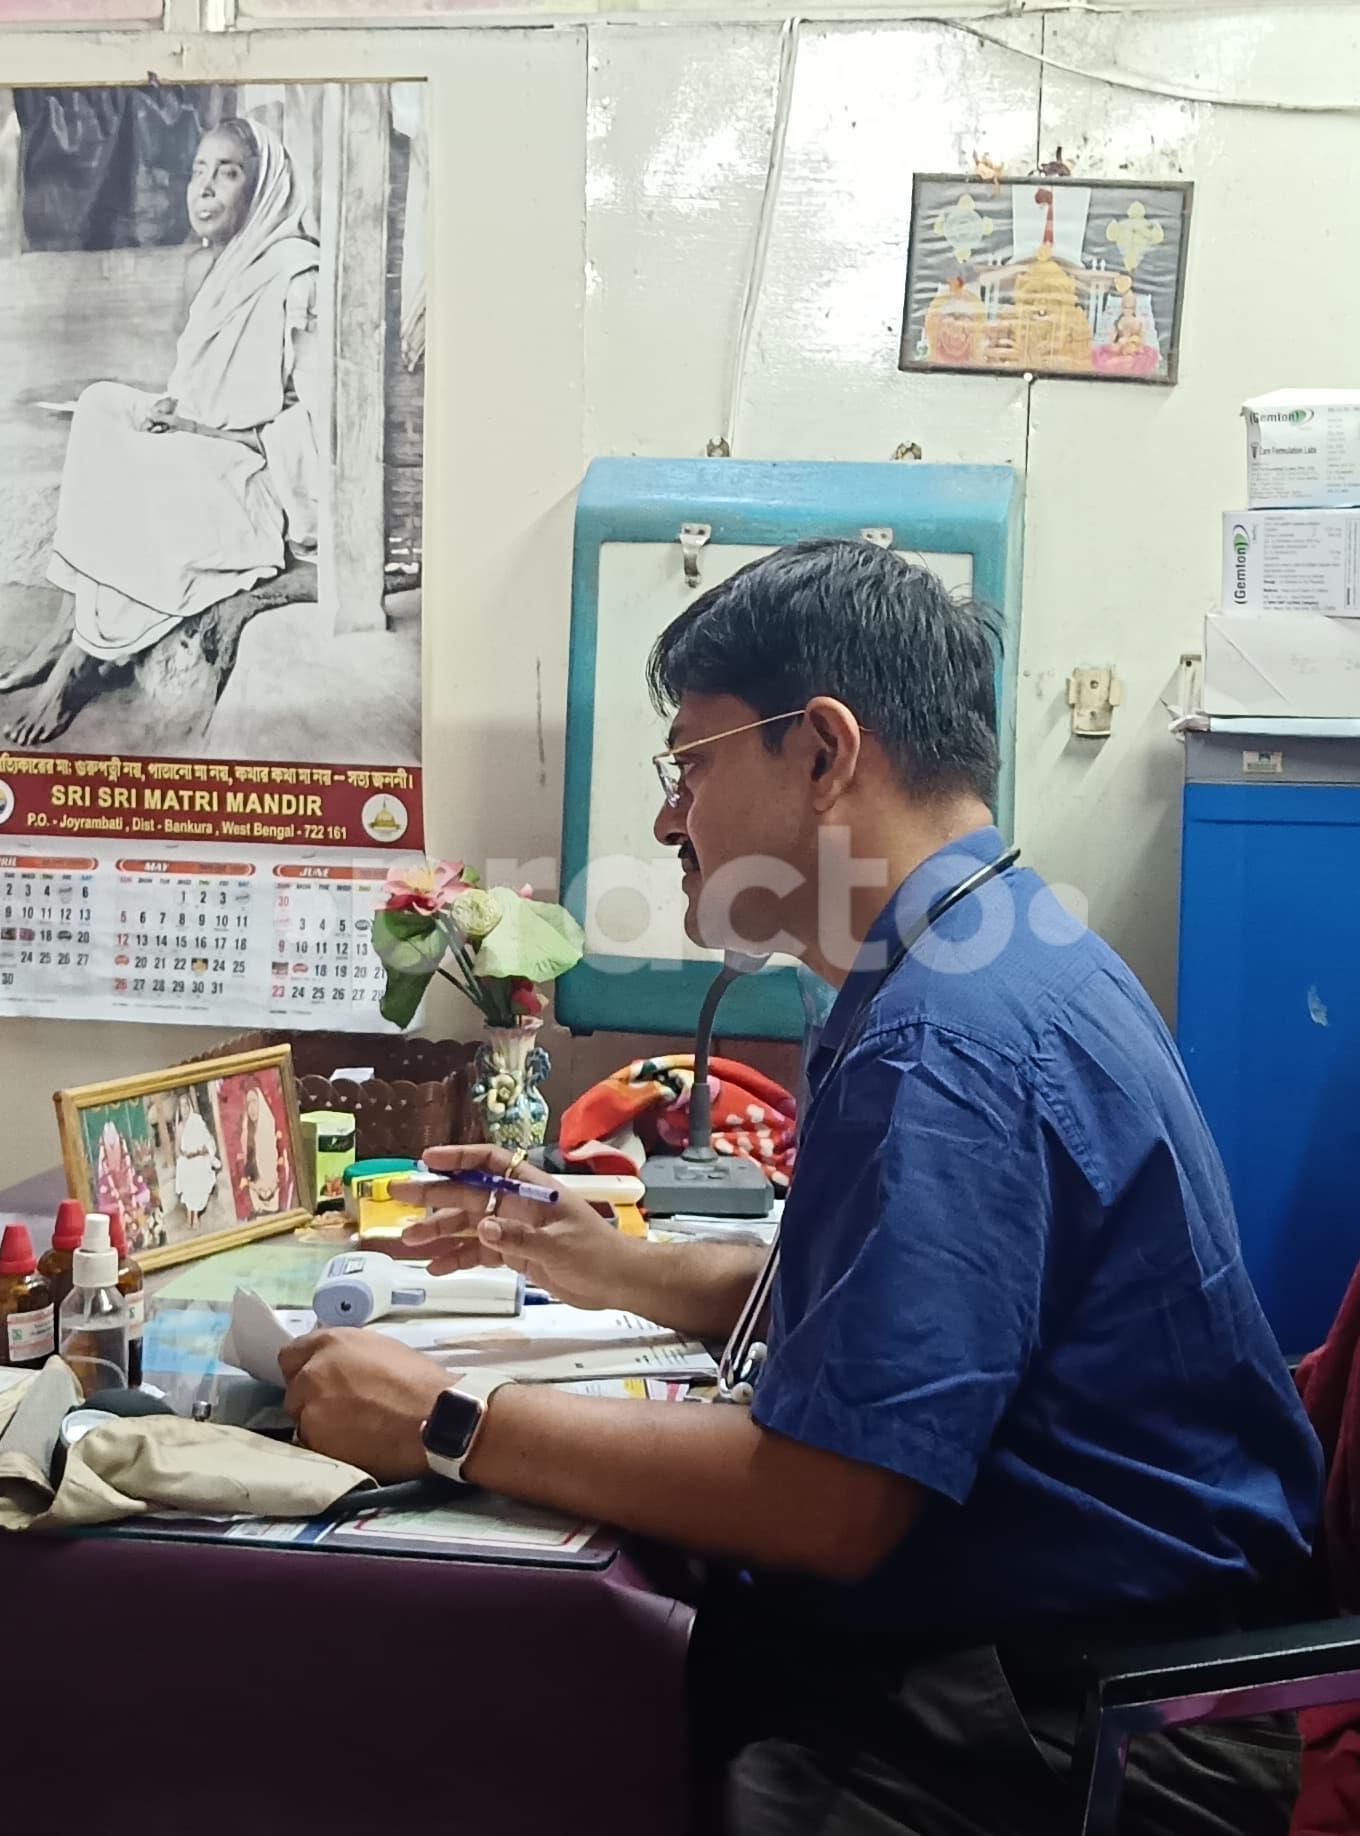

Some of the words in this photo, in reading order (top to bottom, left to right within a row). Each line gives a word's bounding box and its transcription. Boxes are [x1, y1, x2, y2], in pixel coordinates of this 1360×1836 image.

[51, 784, 91, 807] SRI
[98, 786, 137, 809] SRI
[144, 788, 219, 812] MATRI
[226, 791, 323, 817] MANDIR
[27, 812, 50, 827] P.O.
[60, 814, 123, 832] Joyrambati
[132, 817, 155, 832] Dist
[164, 818, 213, 835] Bankura
[222, 820, 251, 836] West
[253, 822, 295, 840] Bengal
[304, 824, 325, 840] 722
[327, 825, 347, 840] 161
[144, 861, 170, 873] MAY
[299, 867, 330, 878] JUNE
[6, 883, 13, 896] 2
[25, 884, 32, 897] 3
[44, 884, 51, 897] 4
[82, 886, 89, 899] 6
[200, 891, 207, 904] 2
[220, 892, 227, 905] 3
[278, 895, 289, 907] 30
[22, 907, 34, 919] 10
[41, 908, 52, 920] 11
[60, 908, 72, 921] 12
[79, 909, 91, 921] 13
[139, 911, 146, 924] 6
[159, 912, 166, 924] 7
[178, 913, 186, 925] 8
[198, 914, 206, 926] 9
[216, 915, 229, 927] 10
[236, 915, 248, 928] 11
[299, 918, 306, 931] 3
[319, 918, 326, 931] 4
[339, 919, 346, 932] 5
[40, 930, 53, 942] 18
[77, 931, 90, 944] 20
[116, 933, 129, 946] 12
[136, 934, 149, 947] 13
[156, 935, 168, 947] 14
[175, 936, 187, 948] 15
[195, 936, 208, 949] 16
[214, 937, 227, 950] 17
[235, 938, 247, 951] 18
[296, 941, 308, 954] 10
[316, 941, 327, 955] 11
[336, 942, 349, 955] 12
[356, 943, 368, 956] 13
[20, 951, 33, 964] 24
[39, 952, 52, 964] 25
[76, 953, 89, 966] 27
[134, 956, 148, 969] 20
[154, 957, 166, 969] 21
[173, 958, 187, 970] 22
[212, 959, 226, 972] 24
[232, 961, 246, 973] 25
[1, 972, 14, 985] 30
[314, 964, 327, 977] 18
[335, 966, 347, 978] 19
[354, 966, 367, 979] 20
[133, 978, 146, 991] 27
[152, 979, 166, 992] 28
[172, 980, 185, 993] 29
[191, 981, 205, 994] 30
[211, 982, 224, 995] 31
[272, 985, 286, 998] 23
[291, 986, 305, 999] 24
[312, 987, 325, 1000] 25
[332, 988, 345, 1001] 26
[351, 989, 365, 1001] 27
